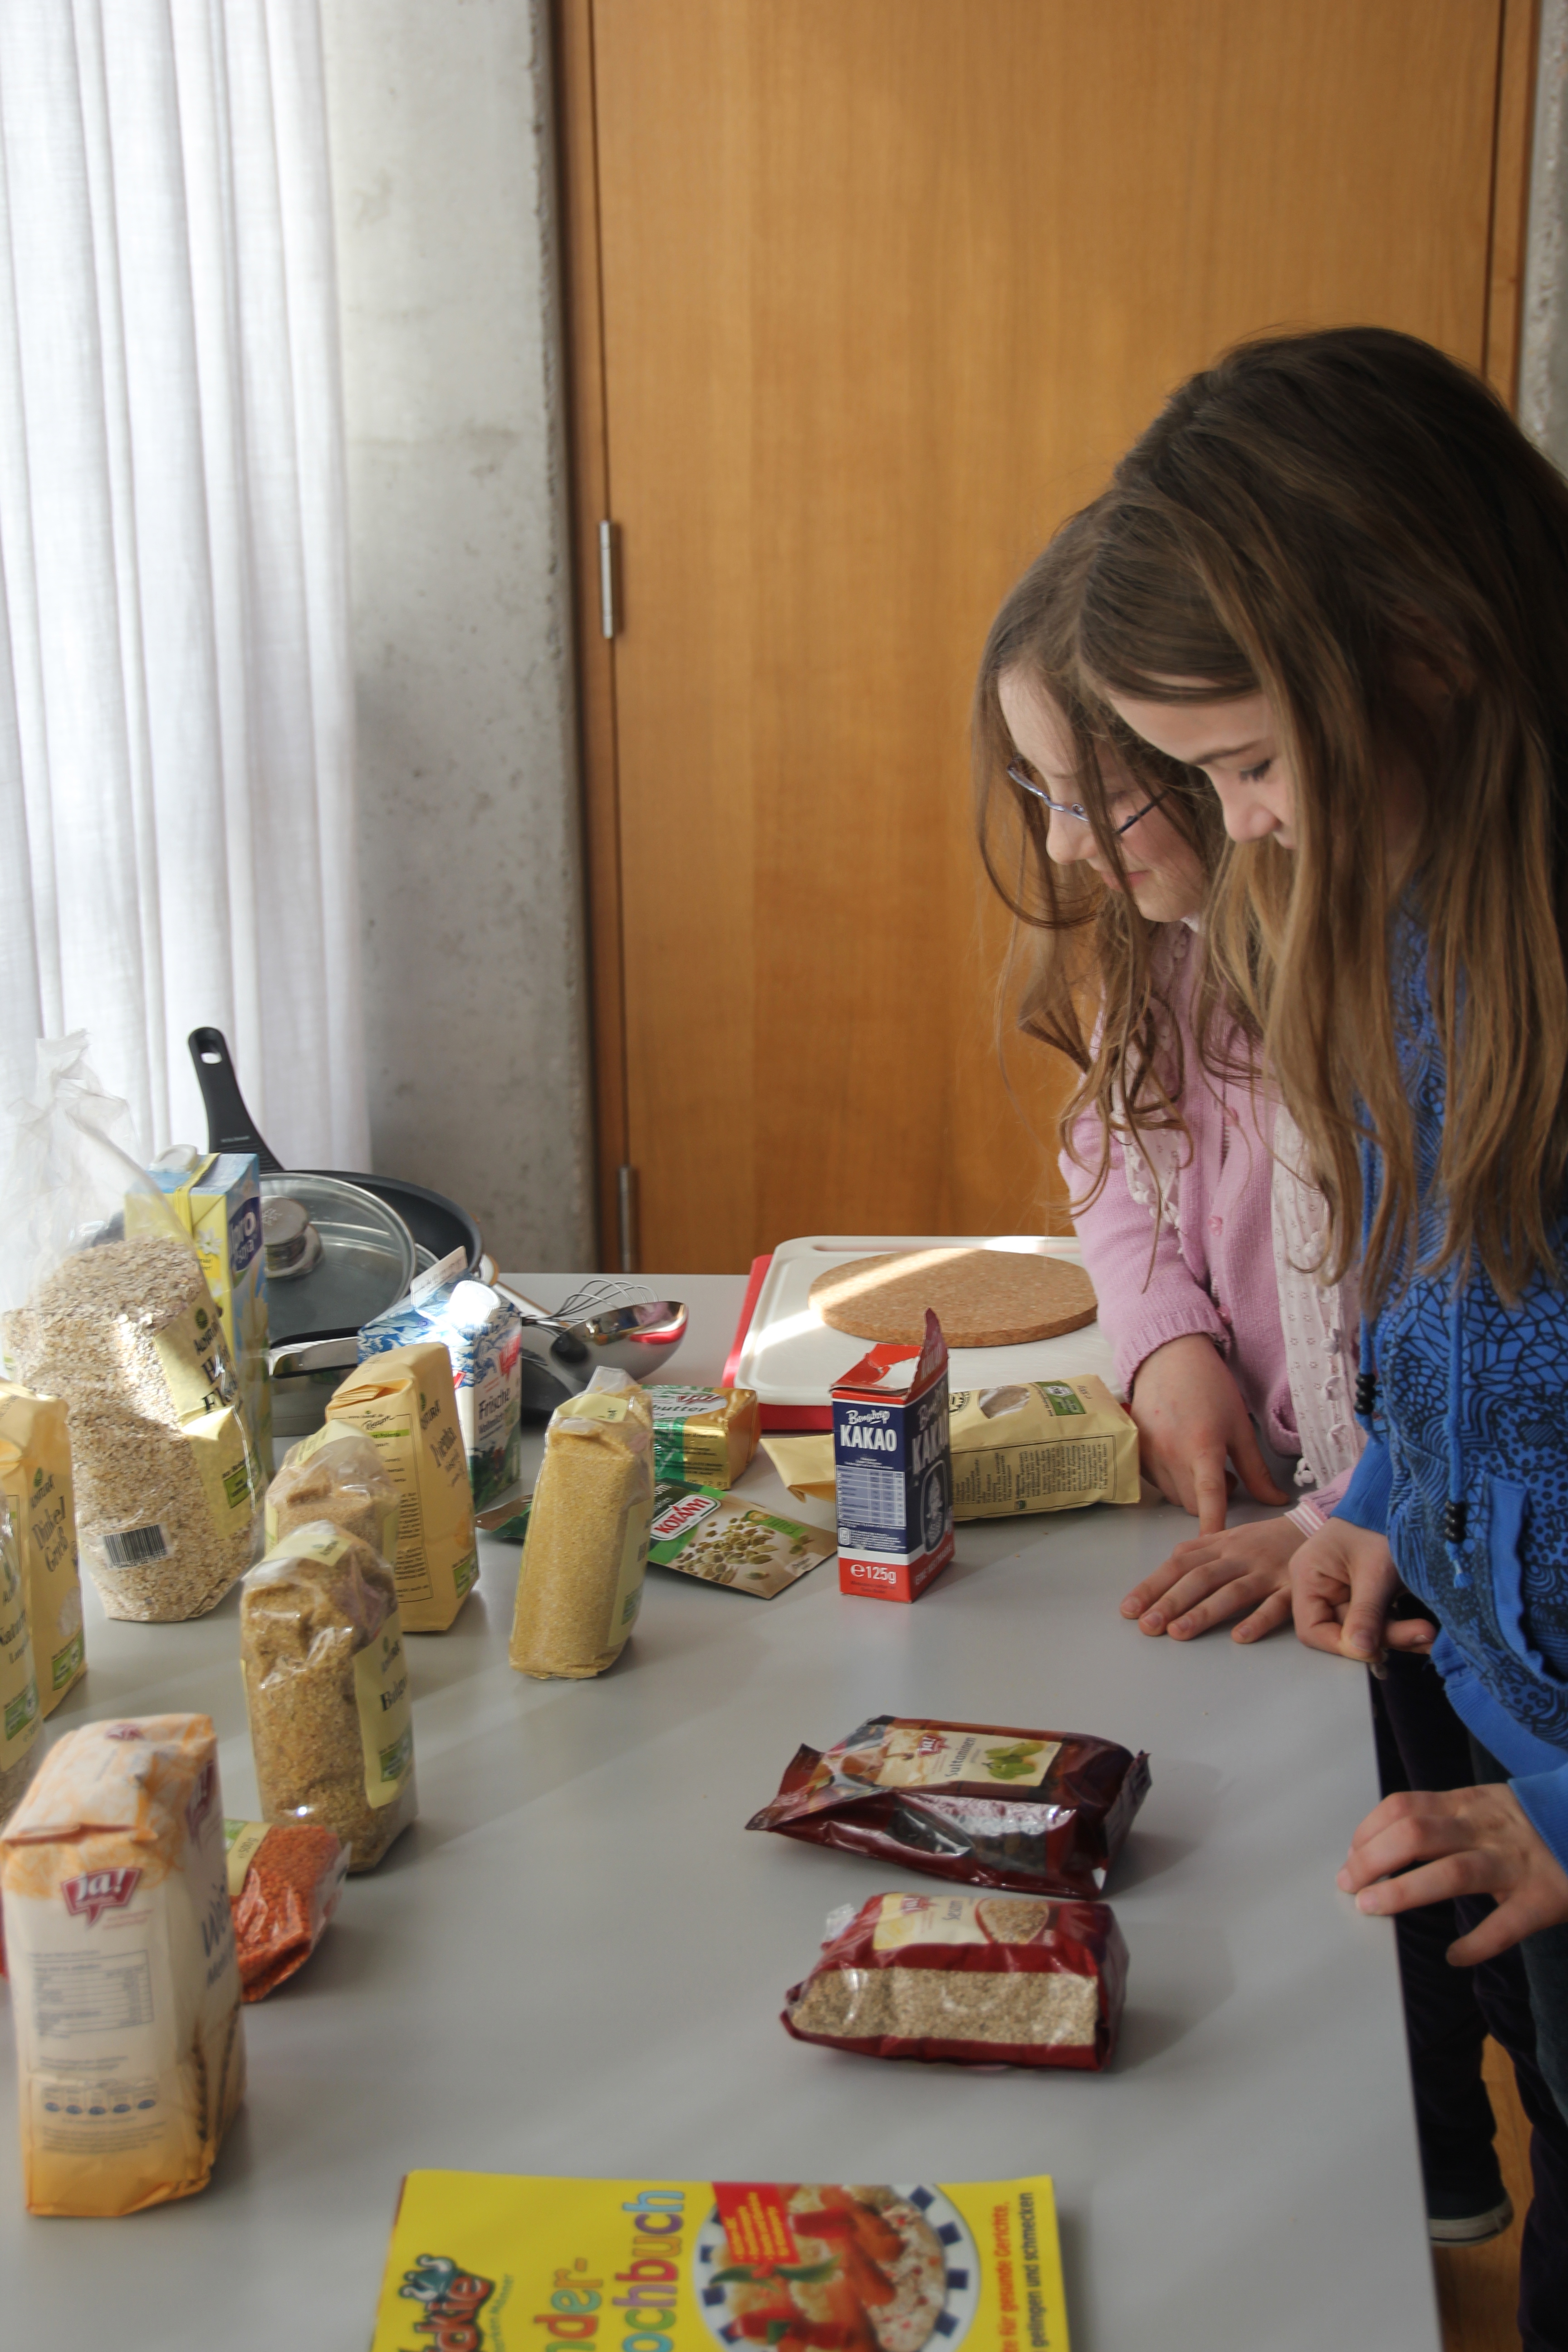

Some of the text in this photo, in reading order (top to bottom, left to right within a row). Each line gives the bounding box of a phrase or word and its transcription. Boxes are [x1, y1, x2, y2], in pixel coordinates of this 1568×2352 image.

[840, 1424, 897, 1452] KAKAO
[654, 1496, 711, 1535] KOTÁNYI
[944, 1736, 977, 1778] Sultaninen
[76, 1868, 127, 1902] ja!
[941, 1900, 963, 1921] Sesam
[612, 2190, 686, 2352] ochbuch
[995, 2259, 1020, 2312] gesunde
[1019, 2191, 1049, 2348] gelingen und schmecken
